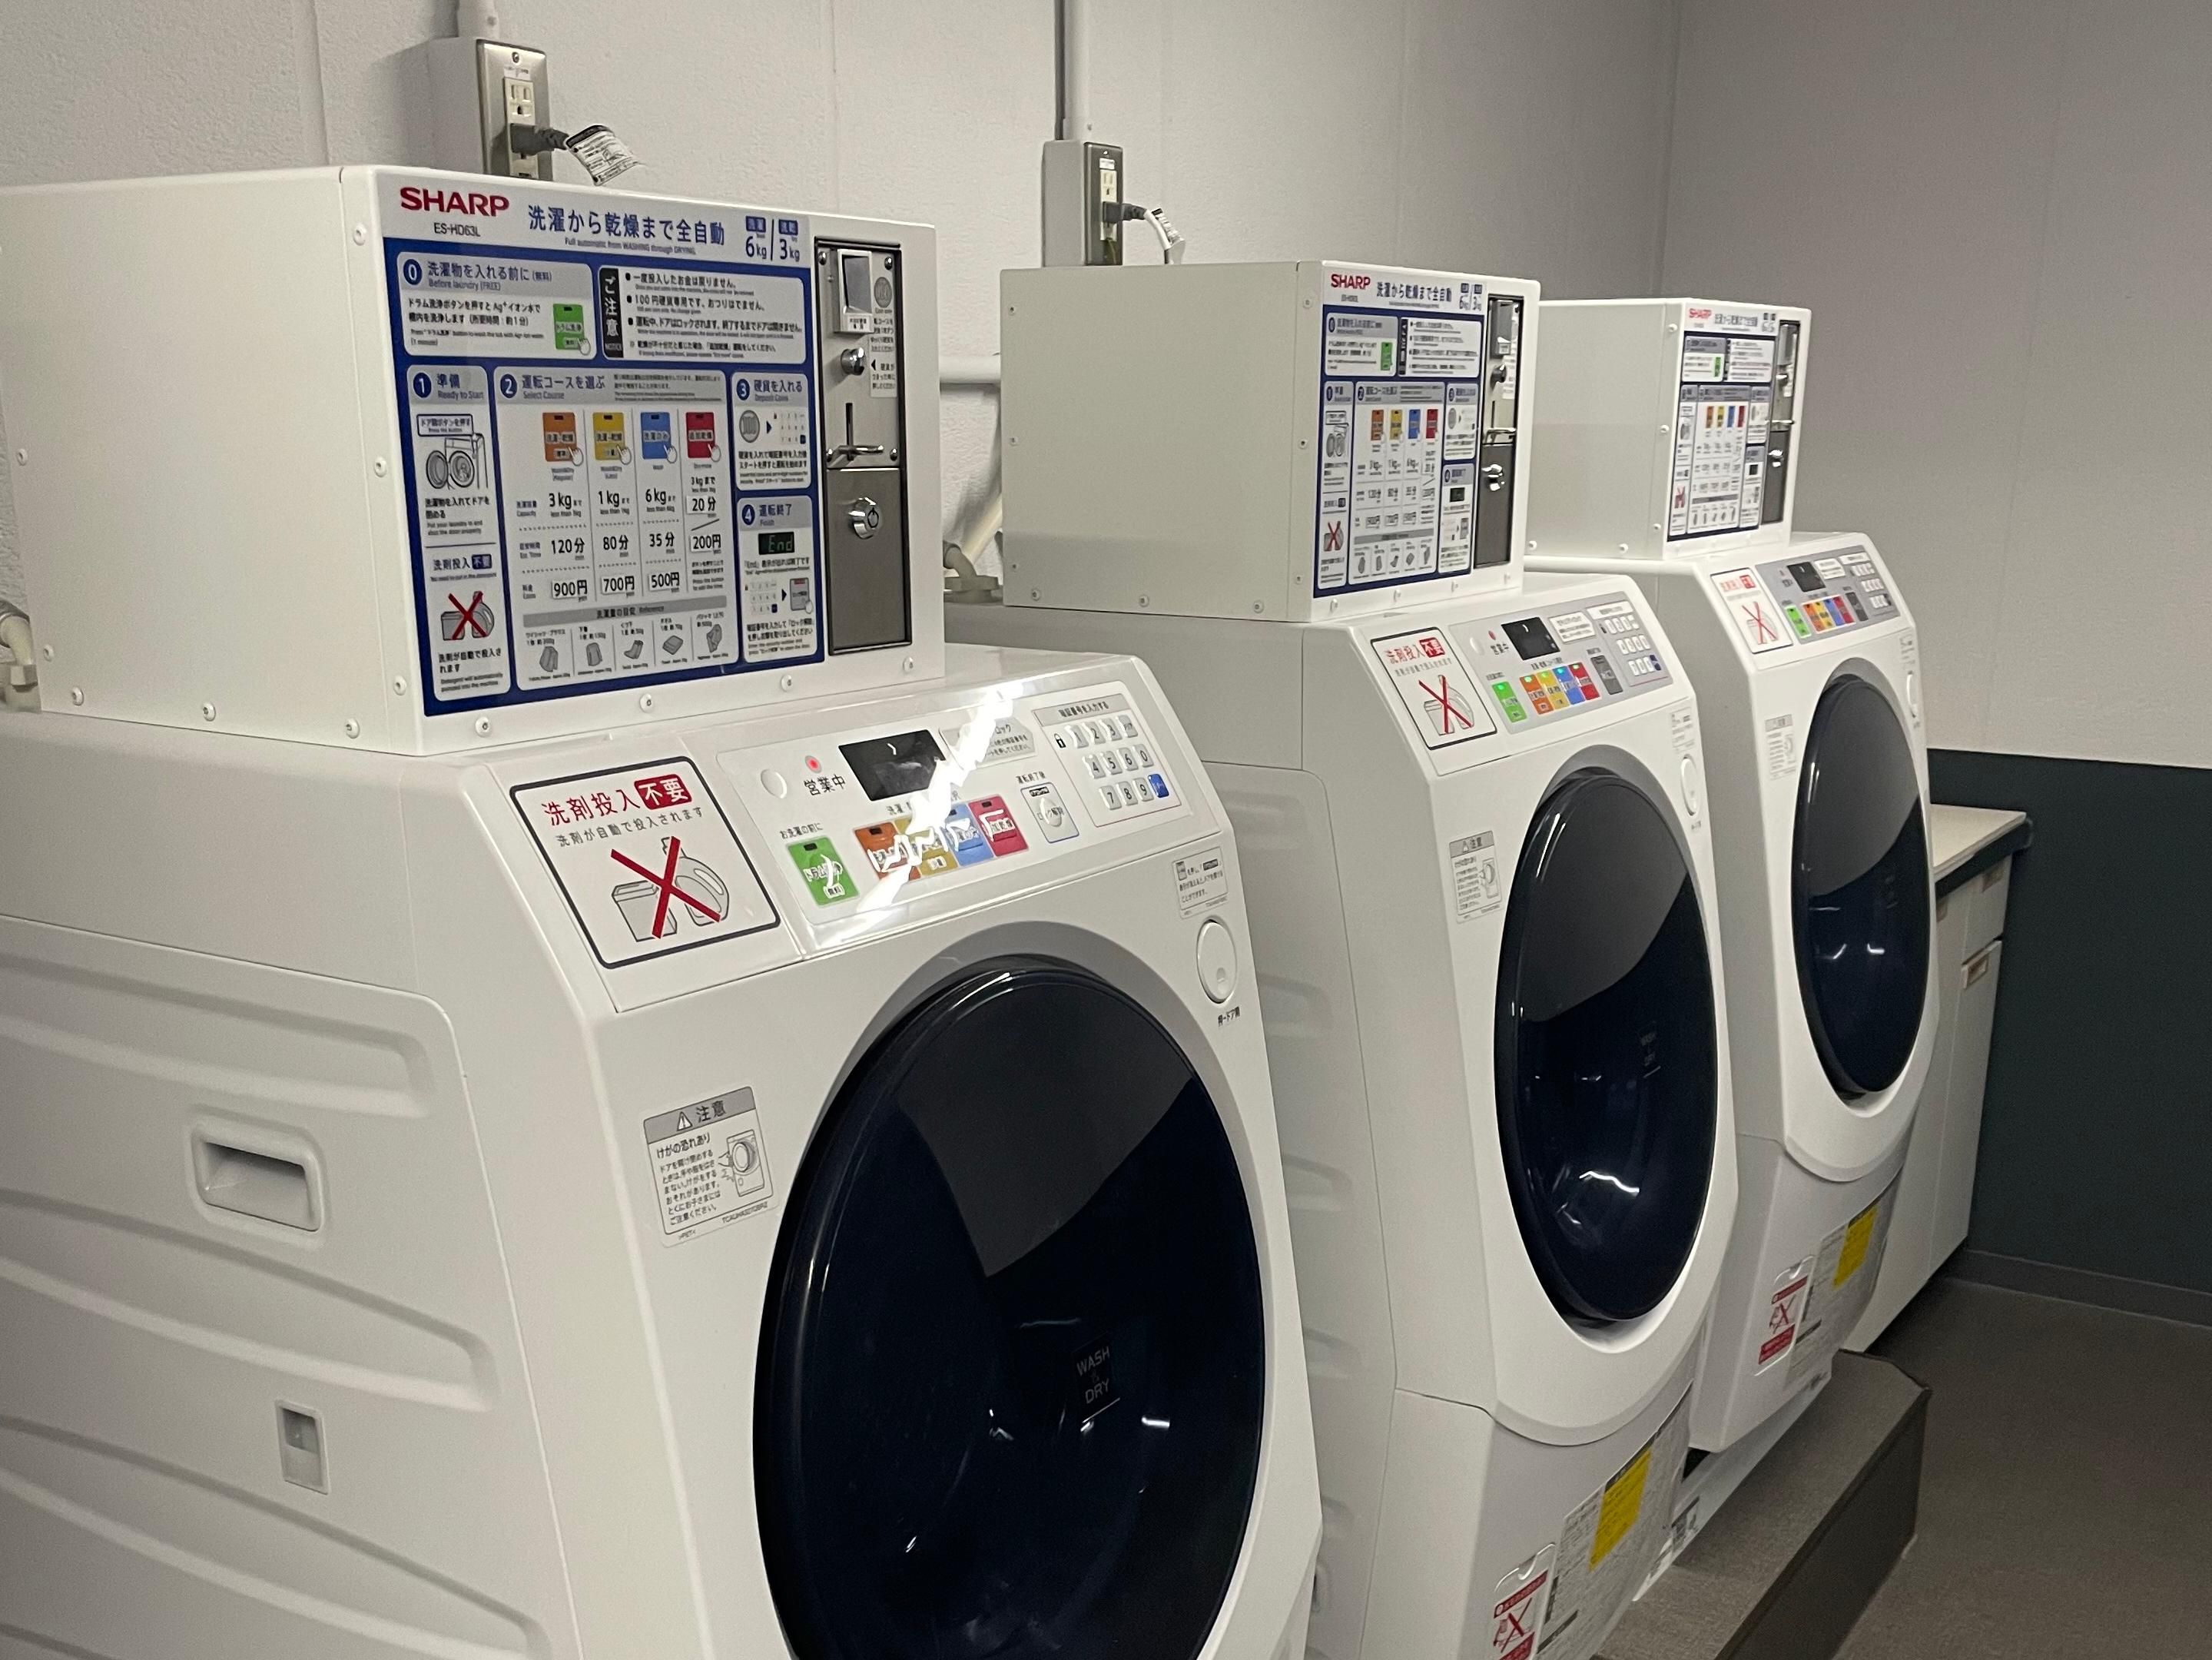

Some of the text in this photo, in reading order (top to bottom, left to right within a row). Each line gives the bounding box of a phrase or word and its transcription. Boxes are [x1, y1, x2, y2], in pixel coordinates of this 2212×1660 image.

[400, 187, 510, 217] SHARP
[528, 204, 725, 246] 洗濯から乾燥まで全自動
[428, 261, 529, 281] 洗濯物を入れる前に
[429, 277, 451, 288] Before
[1331, 274, 1371, 290] SHARP
[438, 390, 459, 400] Ready
[551, 537, 585, 554] 120分
[603, 535, 628, 550] 80分
[649, 532, 675, 547] 35分
[693, 534, 721, 549] 200円
[768, 534, 794, 553] End
[554, 579, 587, 596] 900円
[603, 576, 635, 593] 700円
[652, 572, 679, 589] 500円
[1074, 732, 1082, 742] 1
[1091, 728, 1099, 739] 2
[1107, 724, 1116, 735] 3
[1108, 757, 1116, 769] 5
[1125, 753, 1133, 765] 6
[1140, 750, 1148, 762] 0
[1093, 762, 1099, 773] 4
[804, 774, 845, 796] 営業中
[1140, 784, 1147, 795] 9
[1107, 792, 1114, 804] 7
[1124, 788, 1132, 799] 8
[555, 807, 703, 847] 洗剤が自動で投入されます
[697, 1101, 726, 1123] 注意
[657, 1132, 710, 1159] けがの恐れあり
[1076, 1346, 1110, 1376] WASH
[1085, 1378, 1109, 1404] DRY
